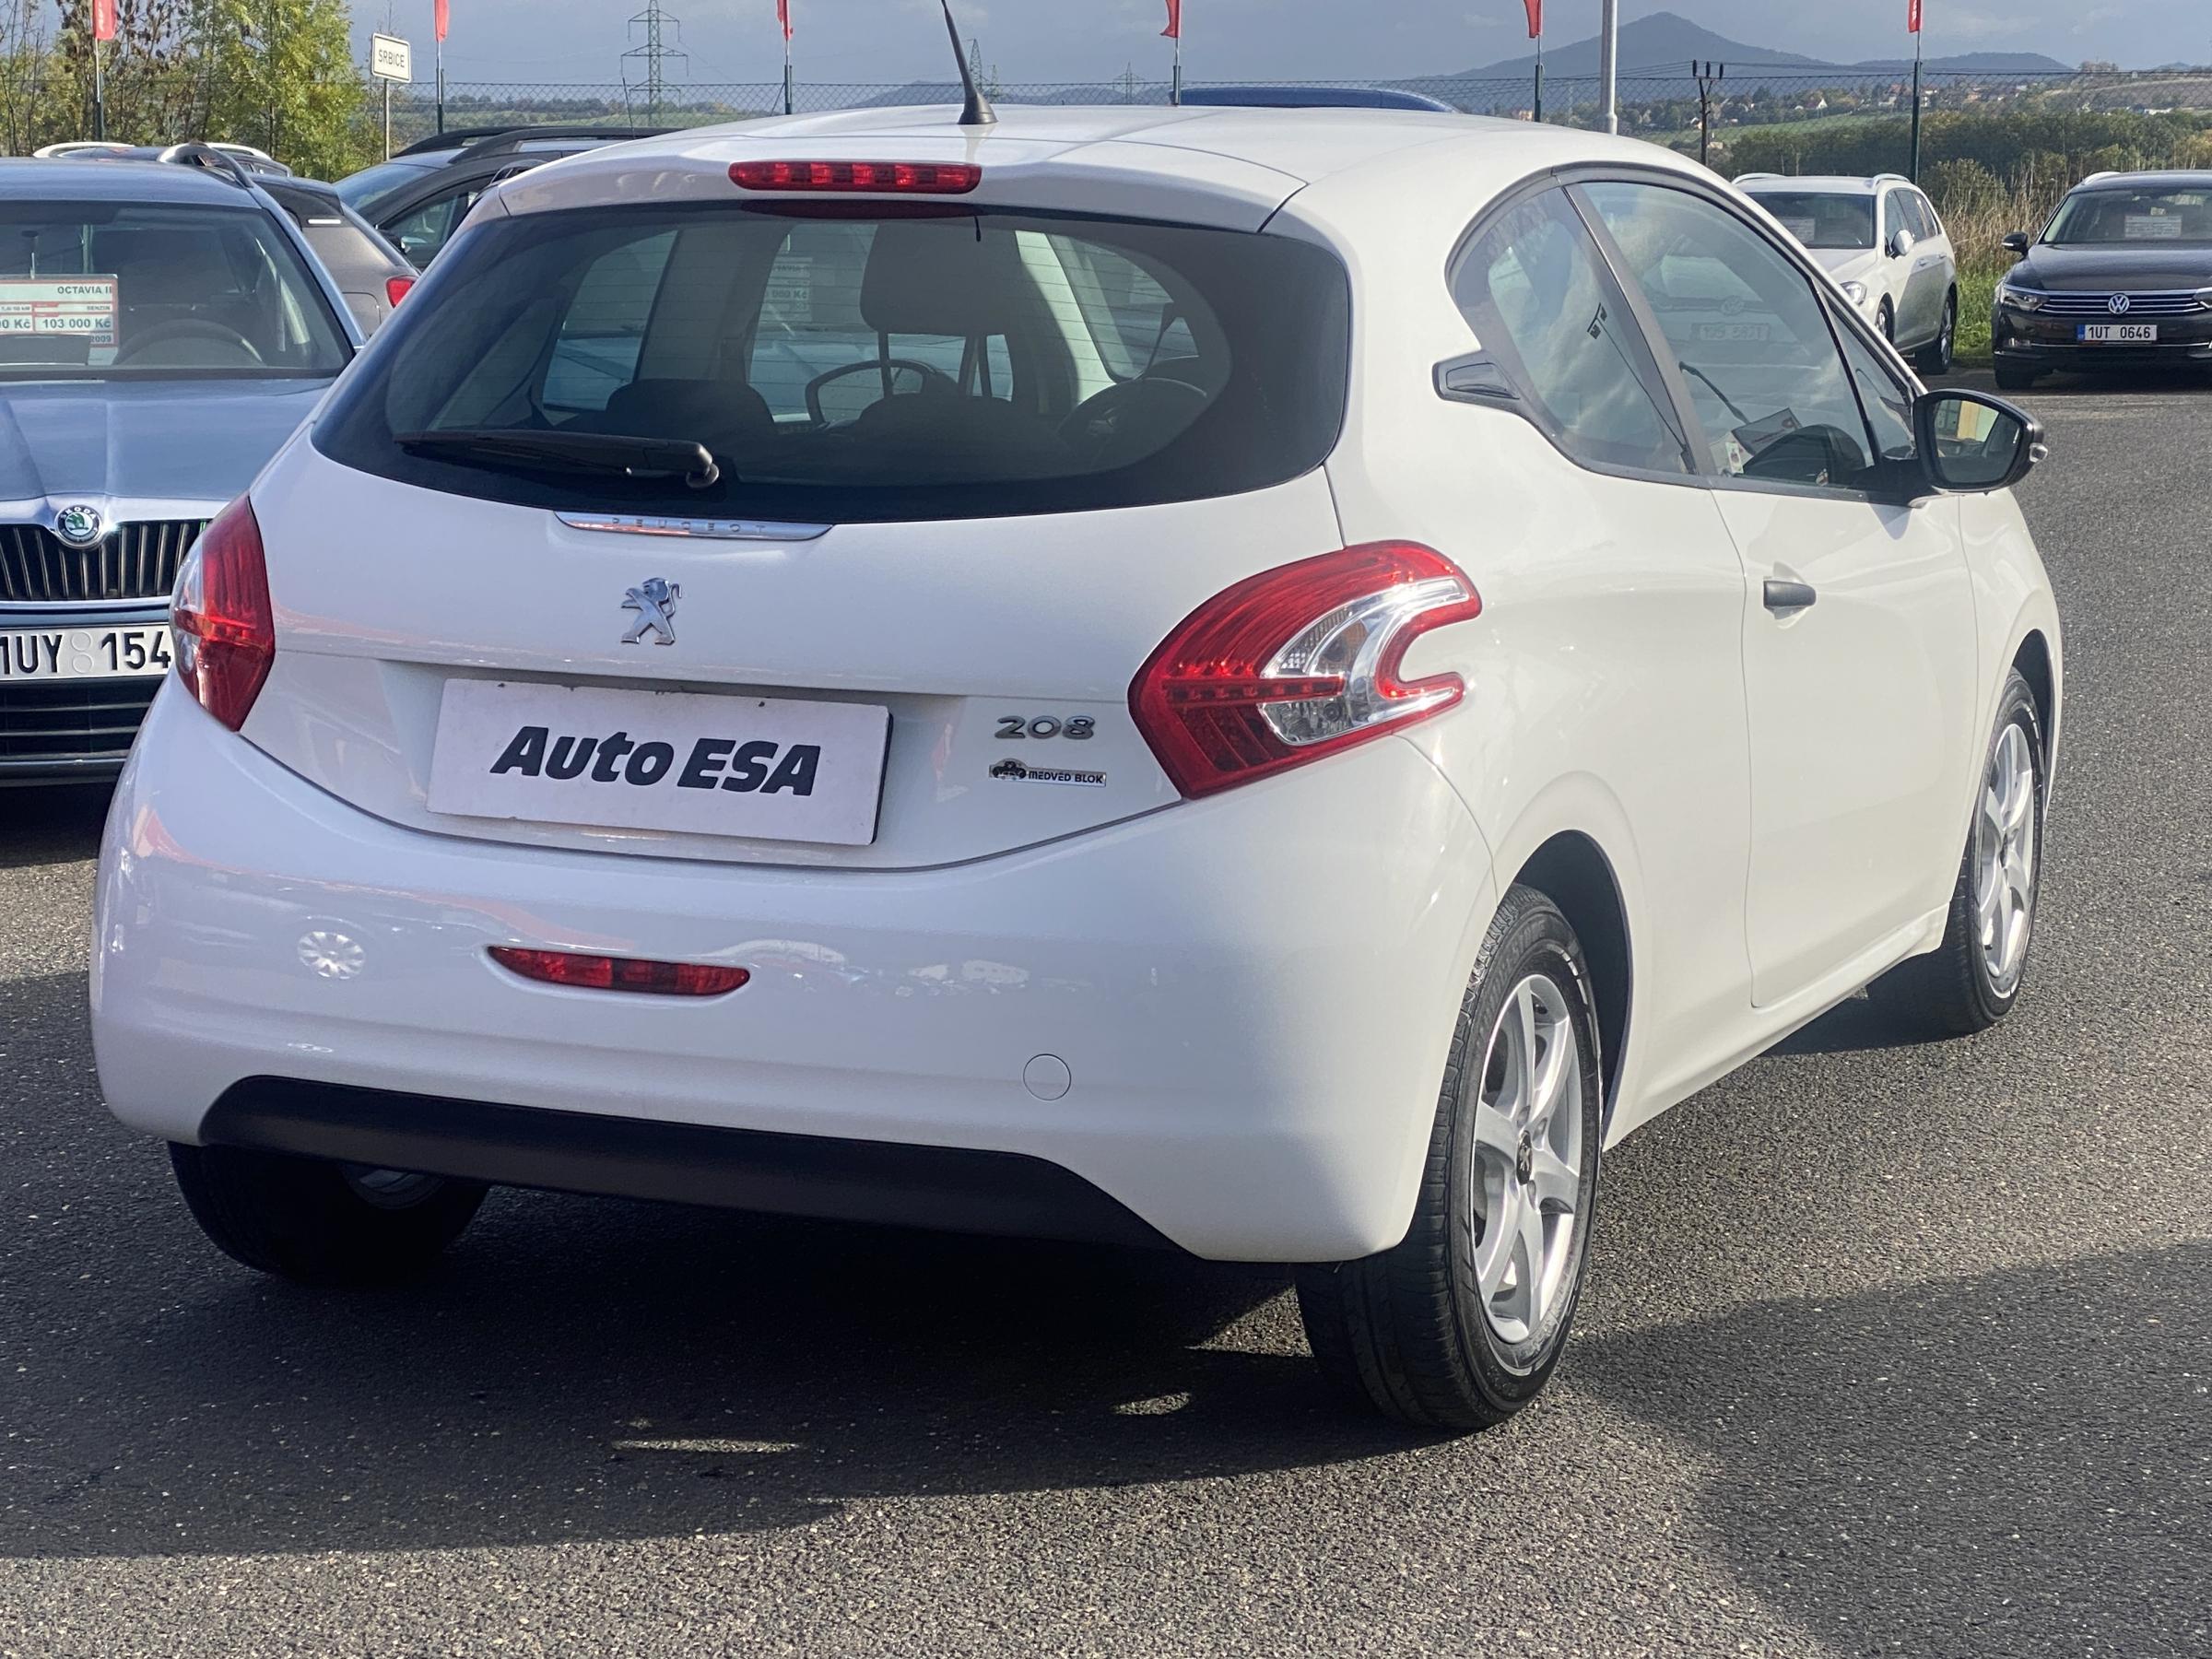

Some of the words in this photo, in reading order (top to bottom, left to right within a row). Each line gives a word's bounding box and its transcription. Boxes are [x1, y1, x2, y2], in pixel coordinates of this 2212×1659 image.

[378, 49, 406, 68] SRBICE
[57, 286, 102, 295] OCTAVIA
[14, 319, 31, 329] Kč
[43, 319, 65, 329] 103
[69, 319, 91, 329] 000
[95, 318, 112, 328] Kč
[2088, 326, 2111, 339] 1UT
[2120, 326, 2151, 339] 0646
[612, 517, 766, 534] PEUGEOT
[0, 634, 64, 675] 1UY
[100, 630, 171, 670] 154
[994, 715, 1096, 740] 208
[489, 725, 675, 786] Auto
[677, 738, 821, 796] ESA
[1075, 774, 1103, 784] BLOK
